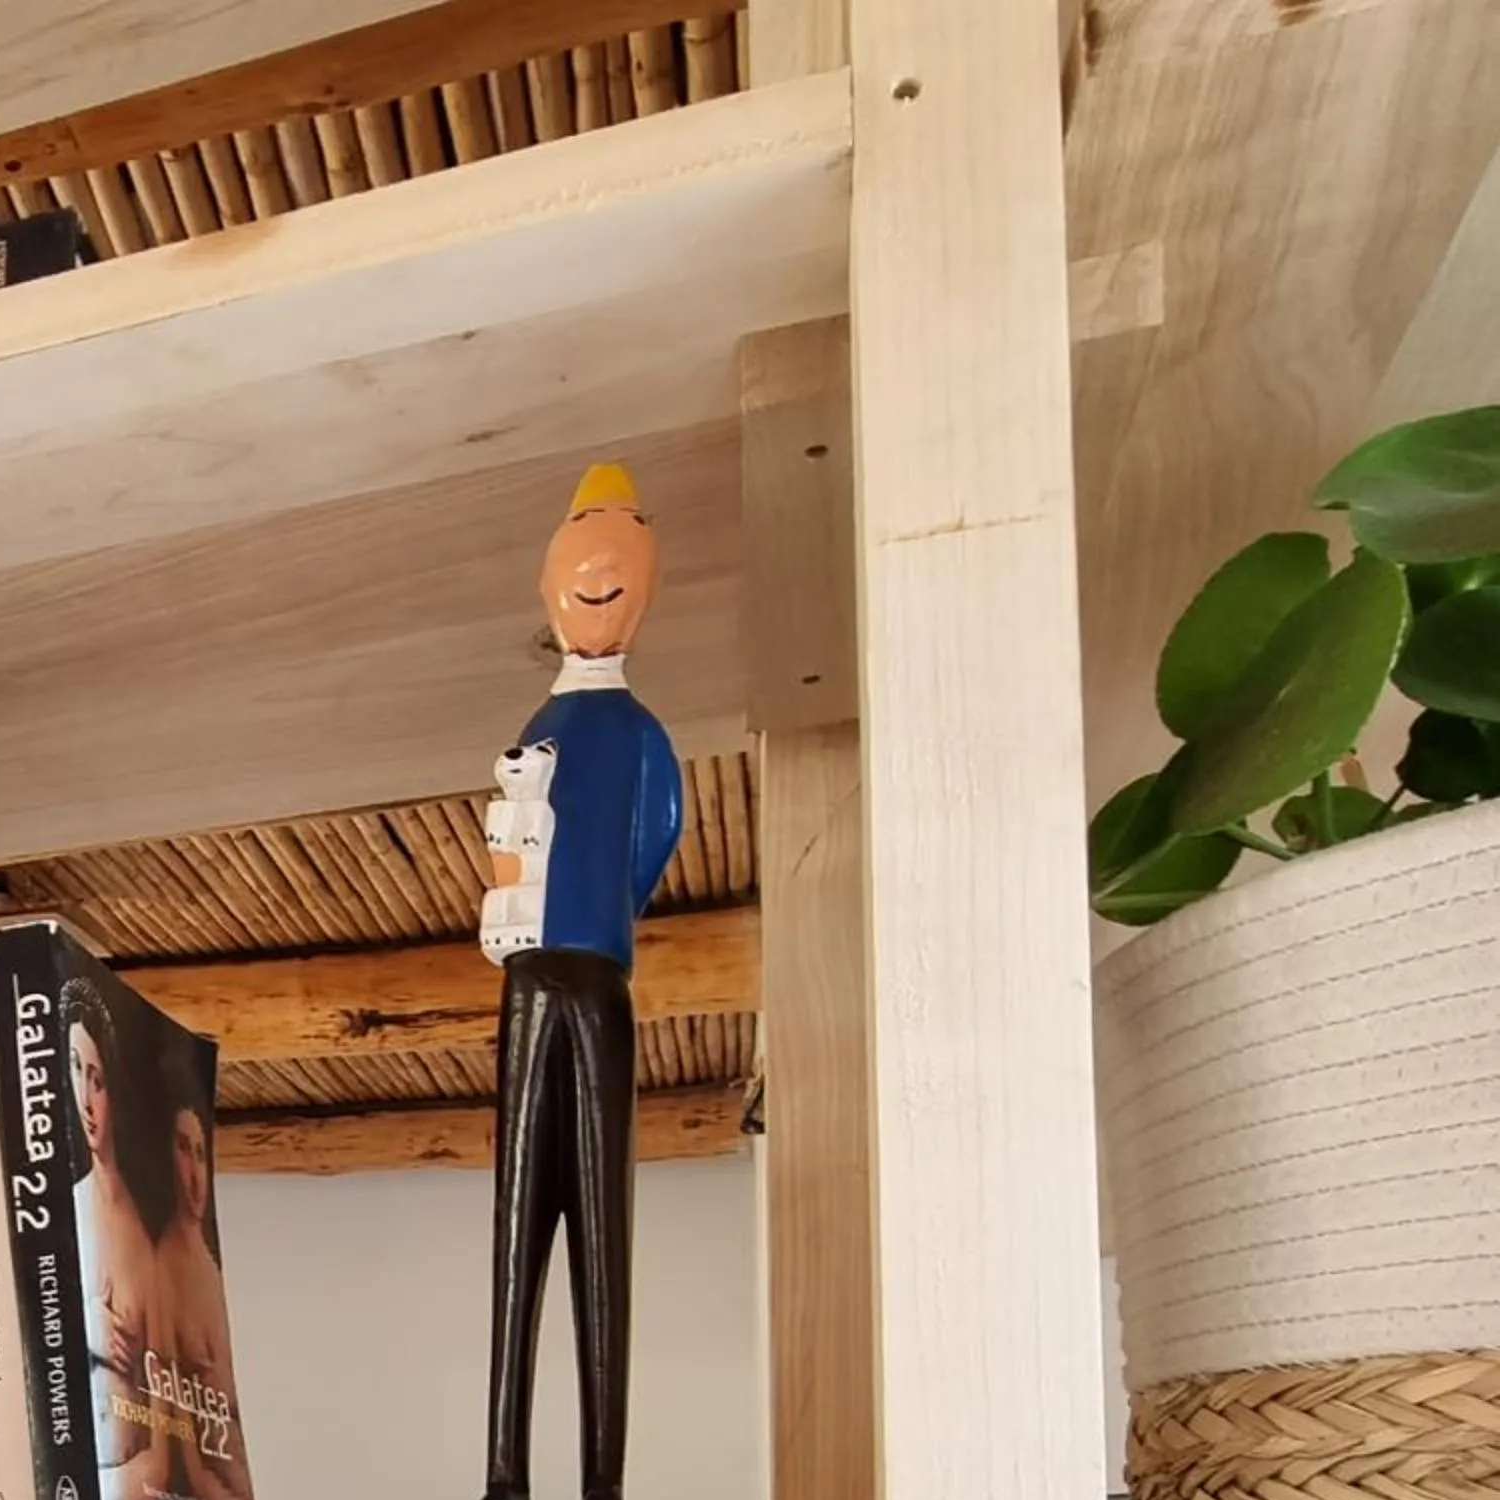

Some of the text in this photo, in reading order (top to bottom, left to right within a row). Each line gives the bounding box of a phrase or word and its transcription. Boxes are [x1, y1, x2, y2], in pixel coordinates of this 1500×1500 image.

[11, 992, 72, 1447] Galatea 2.2 RICHARD POWERS
[142, 1350, 232, 1425] Galatea
